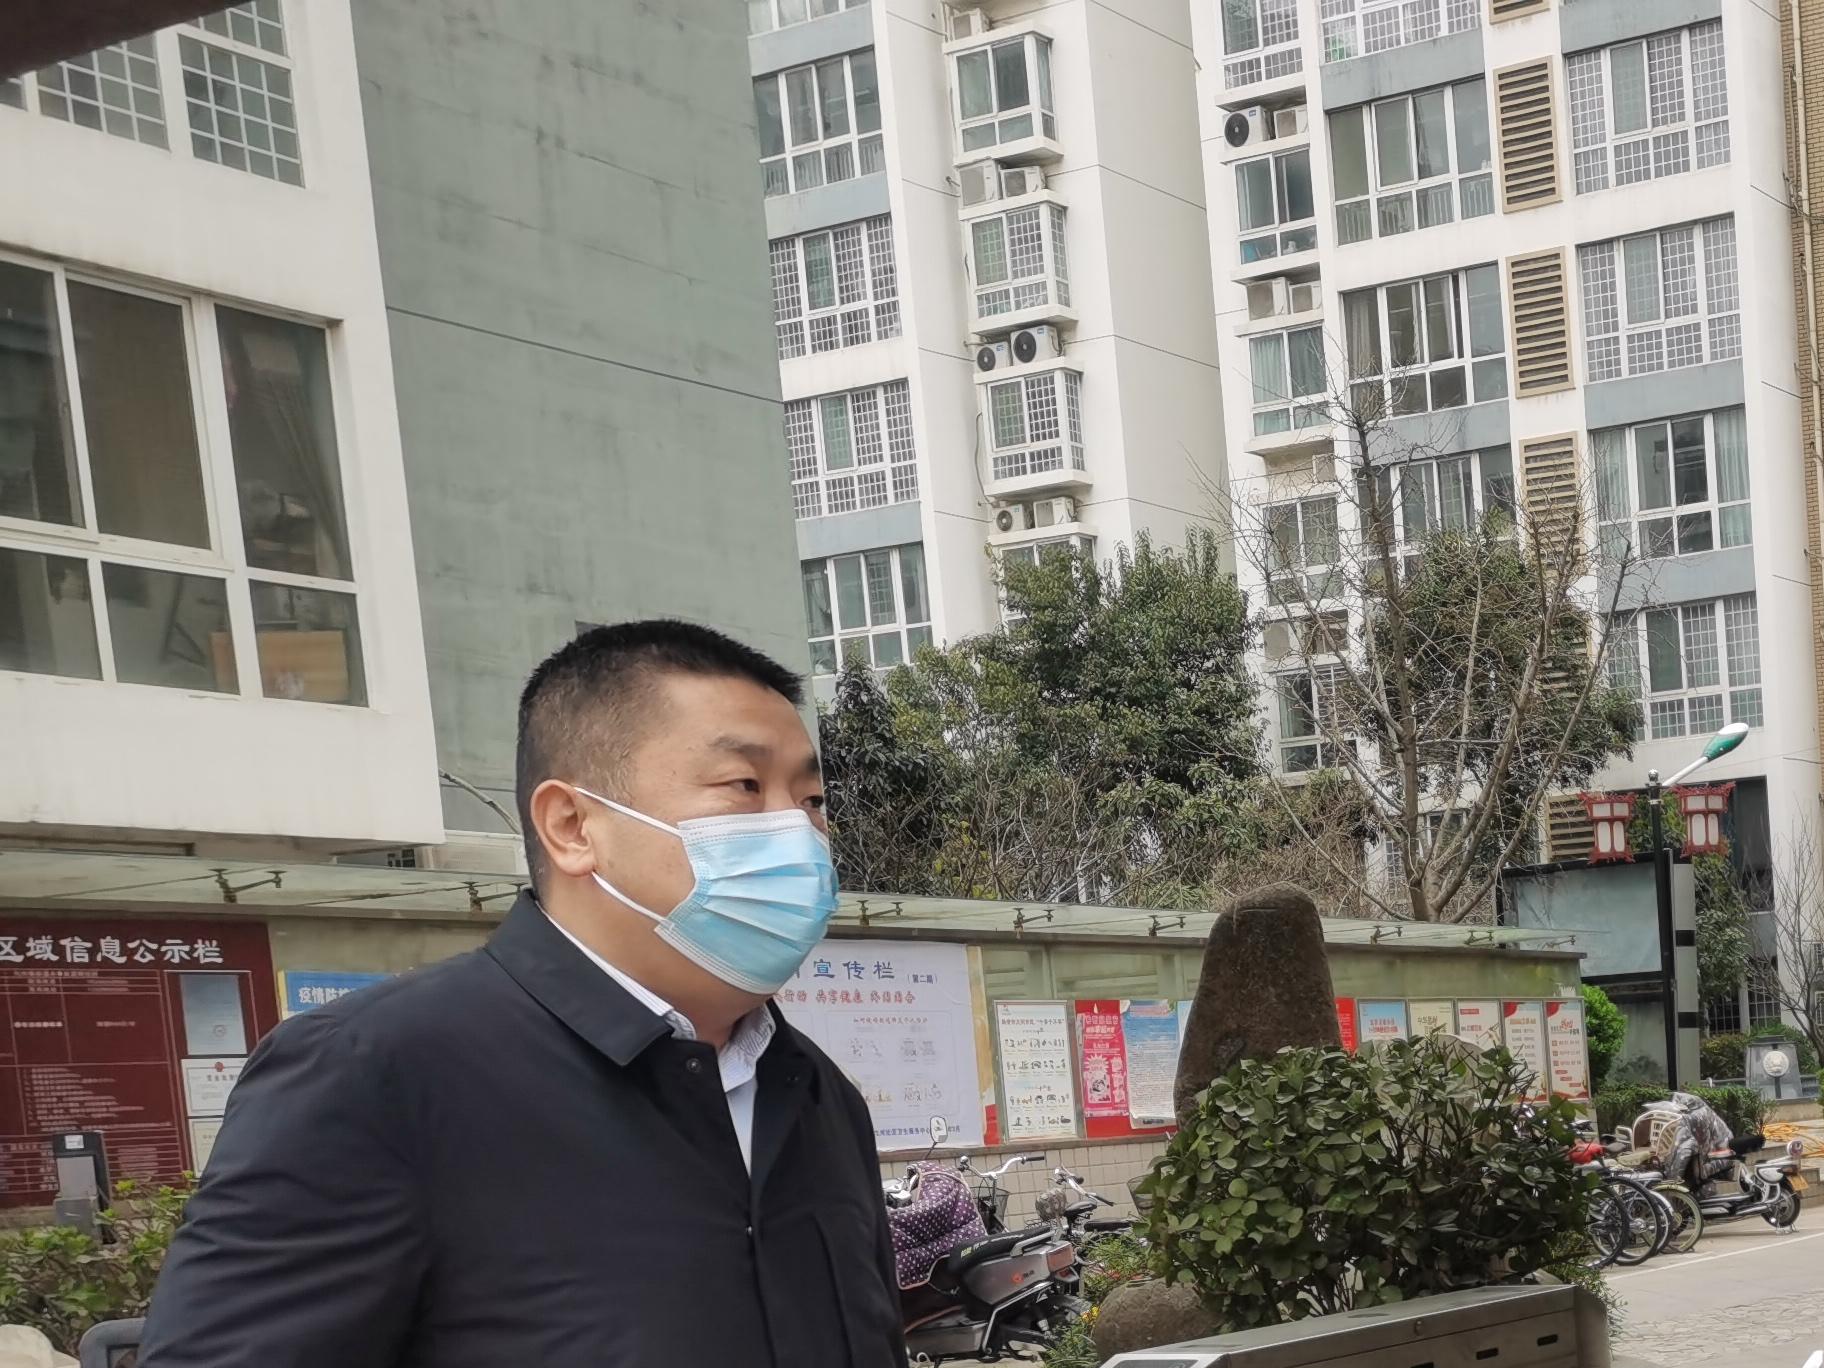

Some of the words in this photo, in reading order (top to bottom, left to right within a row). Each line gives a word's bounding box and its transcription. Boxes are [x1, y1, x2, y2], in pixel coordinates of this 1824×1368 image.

[0, 936, 224, 963] 区域信息公示栏
[795, 958, 896, 981] 宣传栏
